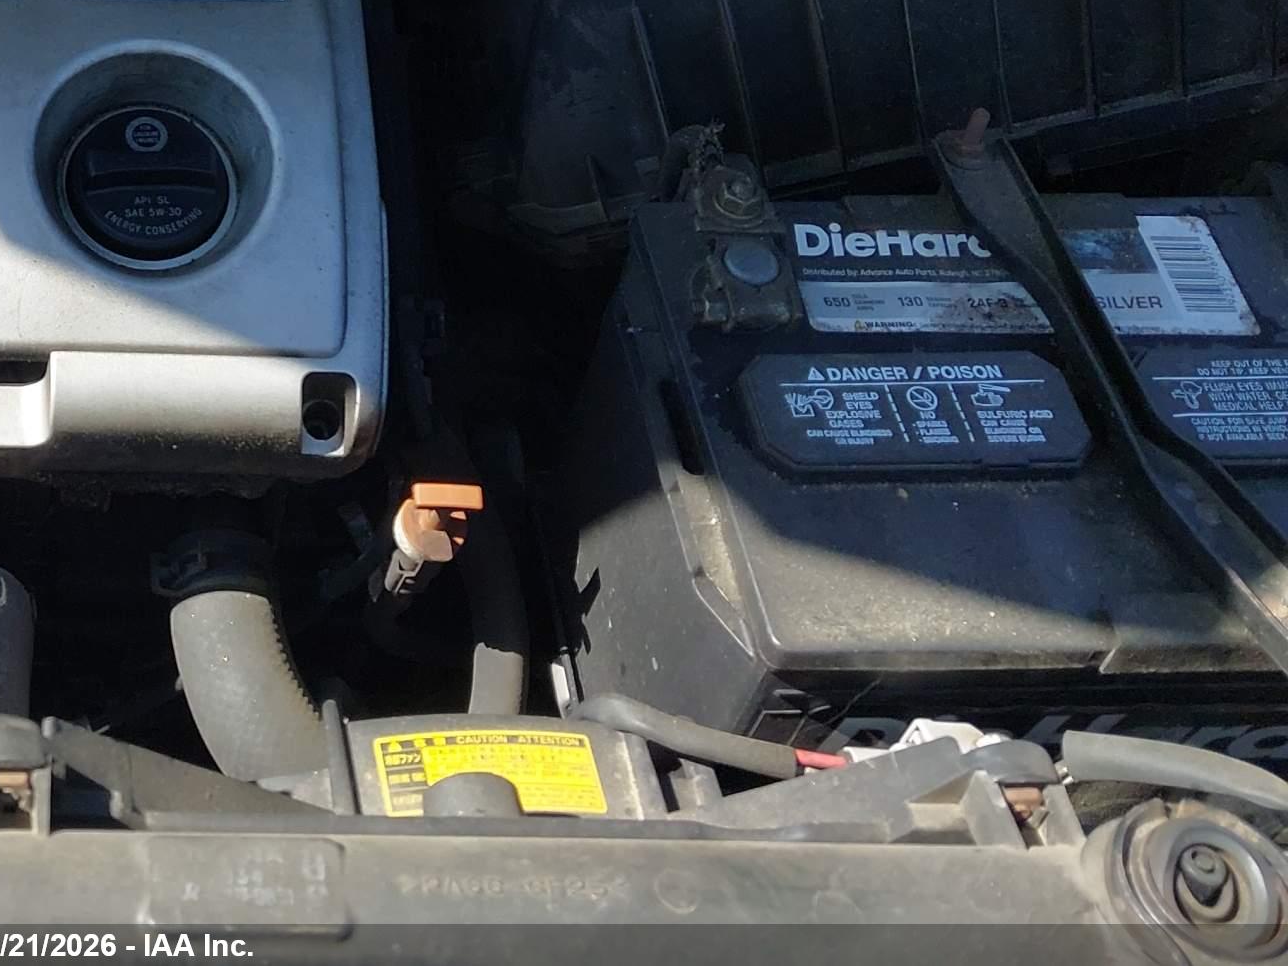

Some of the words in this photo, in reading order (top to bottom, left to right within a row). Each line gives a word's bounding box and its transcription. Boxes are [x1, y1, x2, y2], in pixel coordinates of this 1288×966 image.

[134, 196, 152, 204] API
[157, 196, 171, 204] SL
[124, 208, 145, 218] SAE
[104, 210, 142, 234] ENERGY
[145, 207, 203, 235] CONSERVING
[823, 296, 851, 307] 650
[897, 296, 923, 307] 130
[826, 367, 908, 381] DANGER
[928, 365, 1002, 379] POISON
[1237, 382, 1263, 391] EYES
[842, 391, 880, 400] SHIELD
[1208, 393, 1235, 401] WITH
[845, 401, 873, 409] EYES
[1214, 401, 1258, 411] MEDICAL
[1259, 401, 1284, 410] HELP
[825, 410, 882, 419] EXPLOSIVE
[919, 411, 936, 419] NO
[976, 410, 1027, 418] SULFURIC
[829, 419, 864, 428] GASES
[455, 735, 508, 744] CAUTION
[517, 736, 580, 746] ATTENTION
